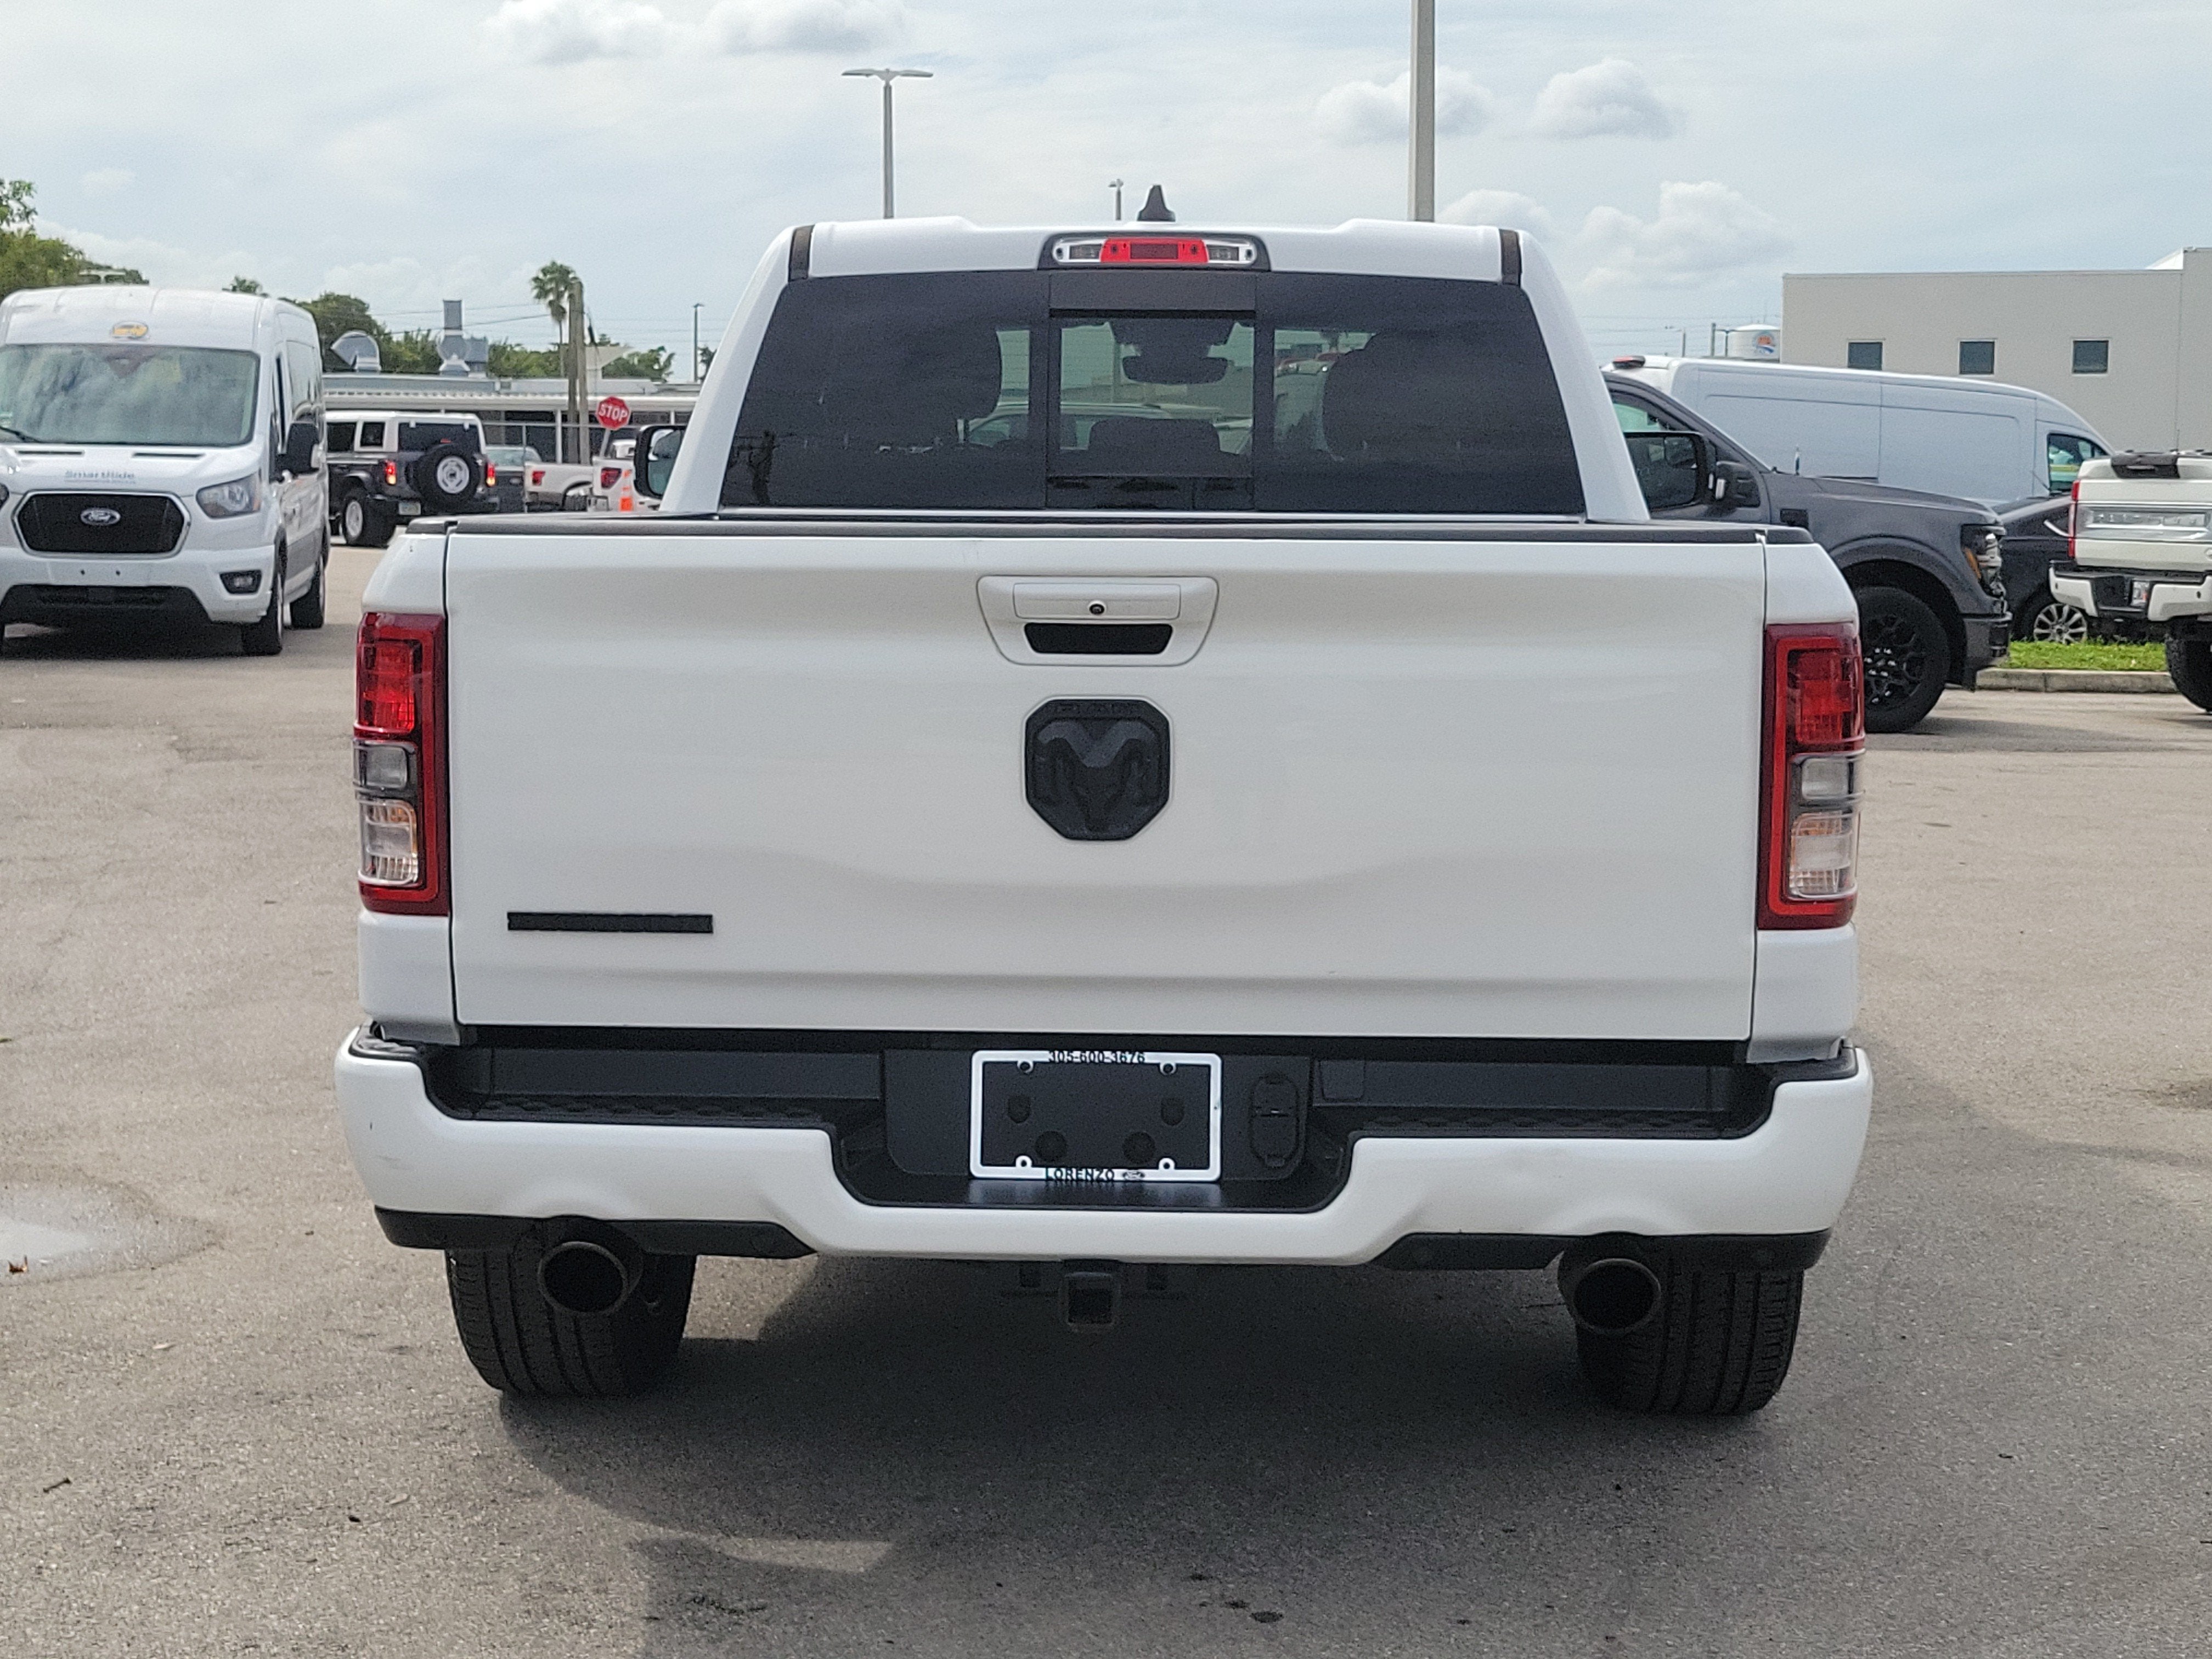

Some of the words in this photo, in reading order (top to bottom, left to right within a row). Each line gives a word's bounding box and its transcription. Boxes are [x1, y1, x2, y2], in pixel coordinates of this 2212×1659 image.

[598, 404, 628, 421] STOP
[1048, 1050, 1146, 1063] 305-600-3676
[1045, 1167, 1115, 1181] LORENZO
